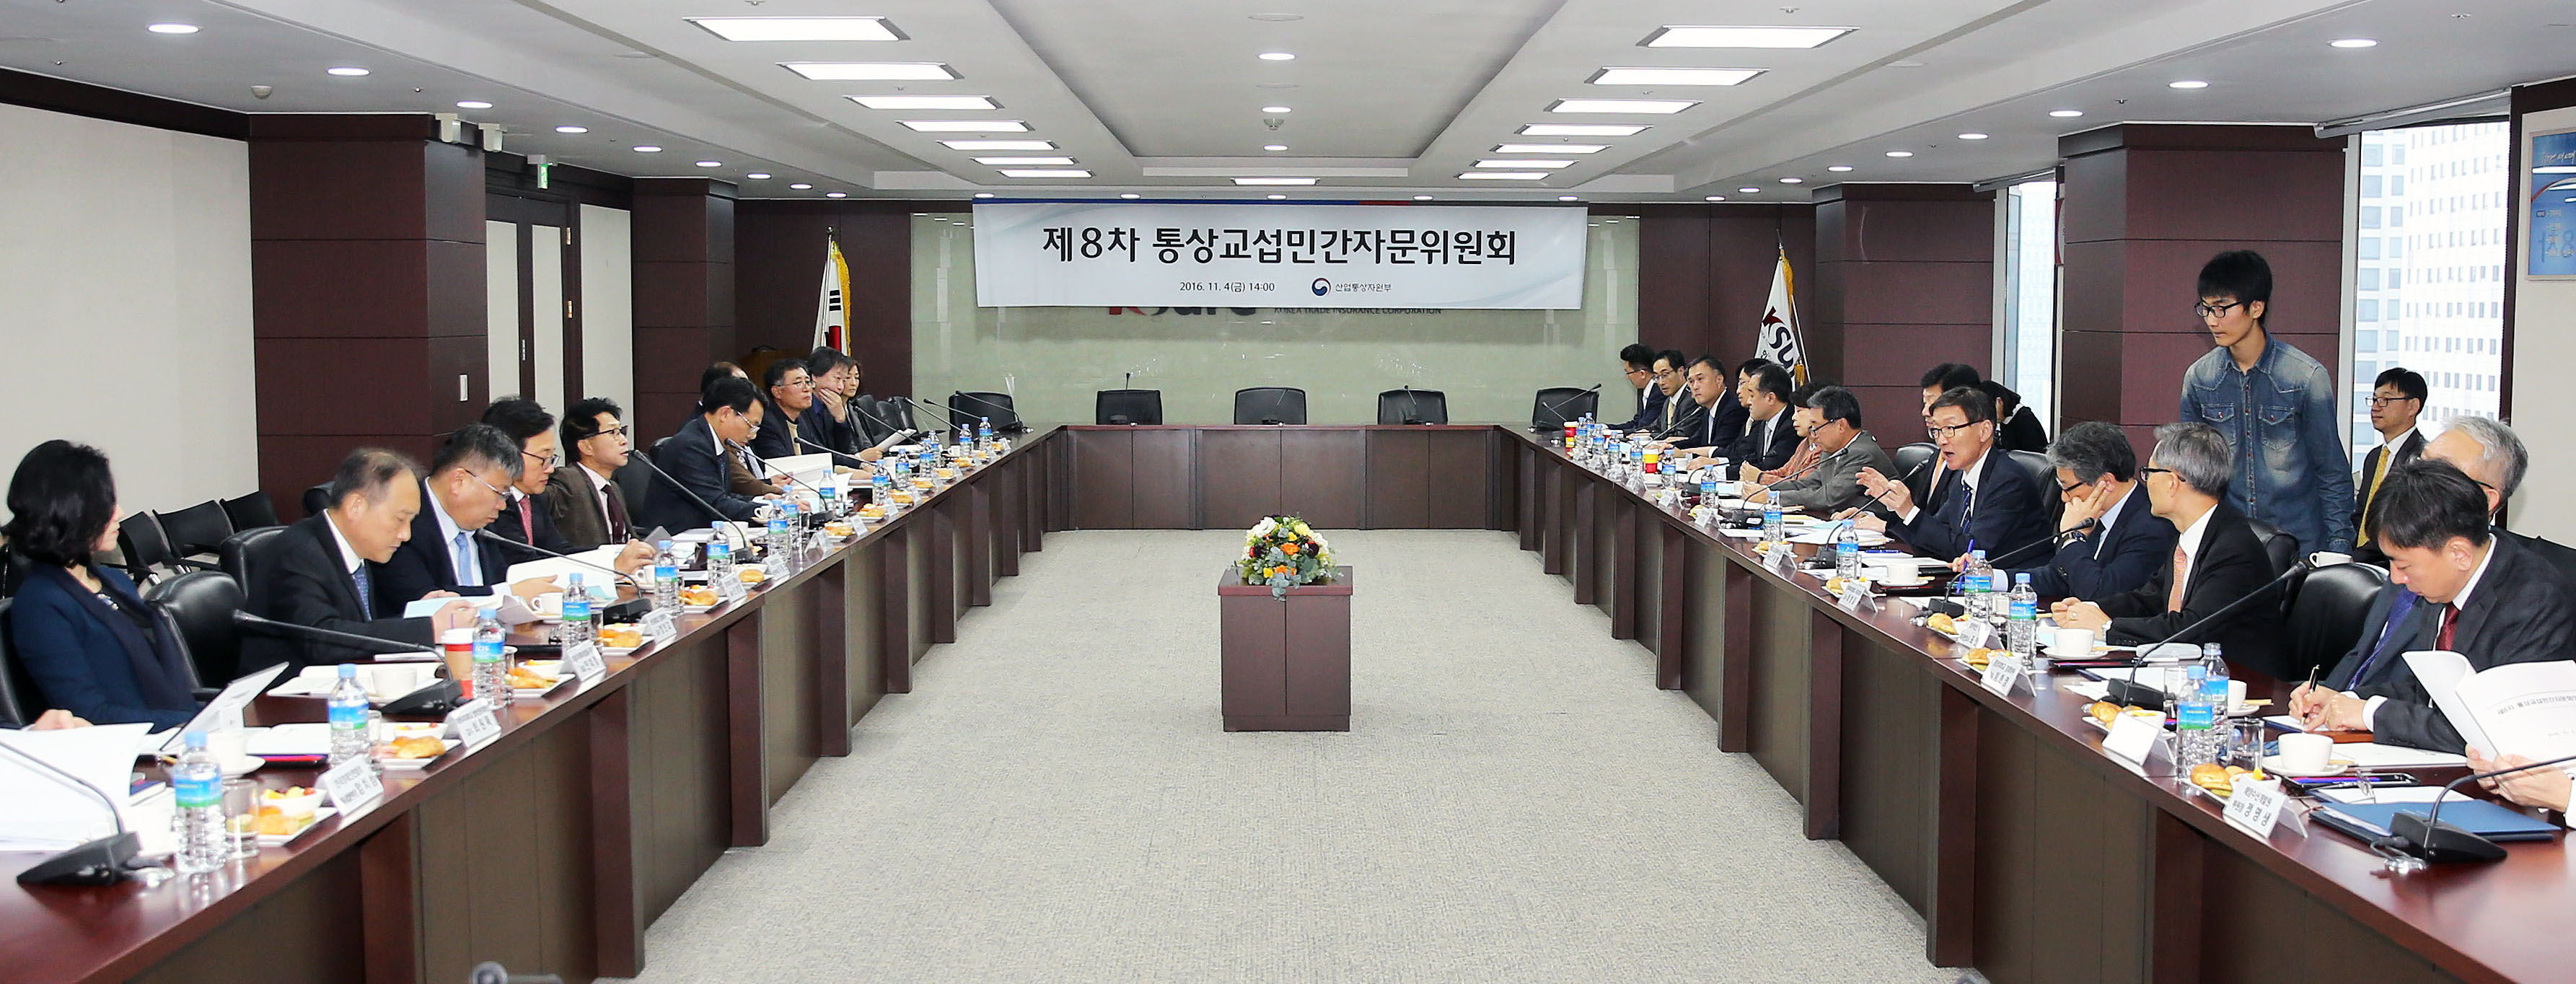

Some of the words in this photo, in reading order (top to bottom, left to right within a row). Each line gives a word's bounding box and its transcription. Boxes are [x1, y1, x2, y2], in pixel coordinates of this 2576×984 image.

[1042, 227, 1140, 263] 제8차
[1152, 228, 1516, 265] 통상교섭민간자문위원회
[1179, 281, 1205, 291] 2016.
[1208, 282, 1221, 291] 11.
[1224, 281, 1246, 293] 4(금)
[1249, 282, 1275, 291] 14:00
[1335, 282, 1392, 293] 산업통상자원부
